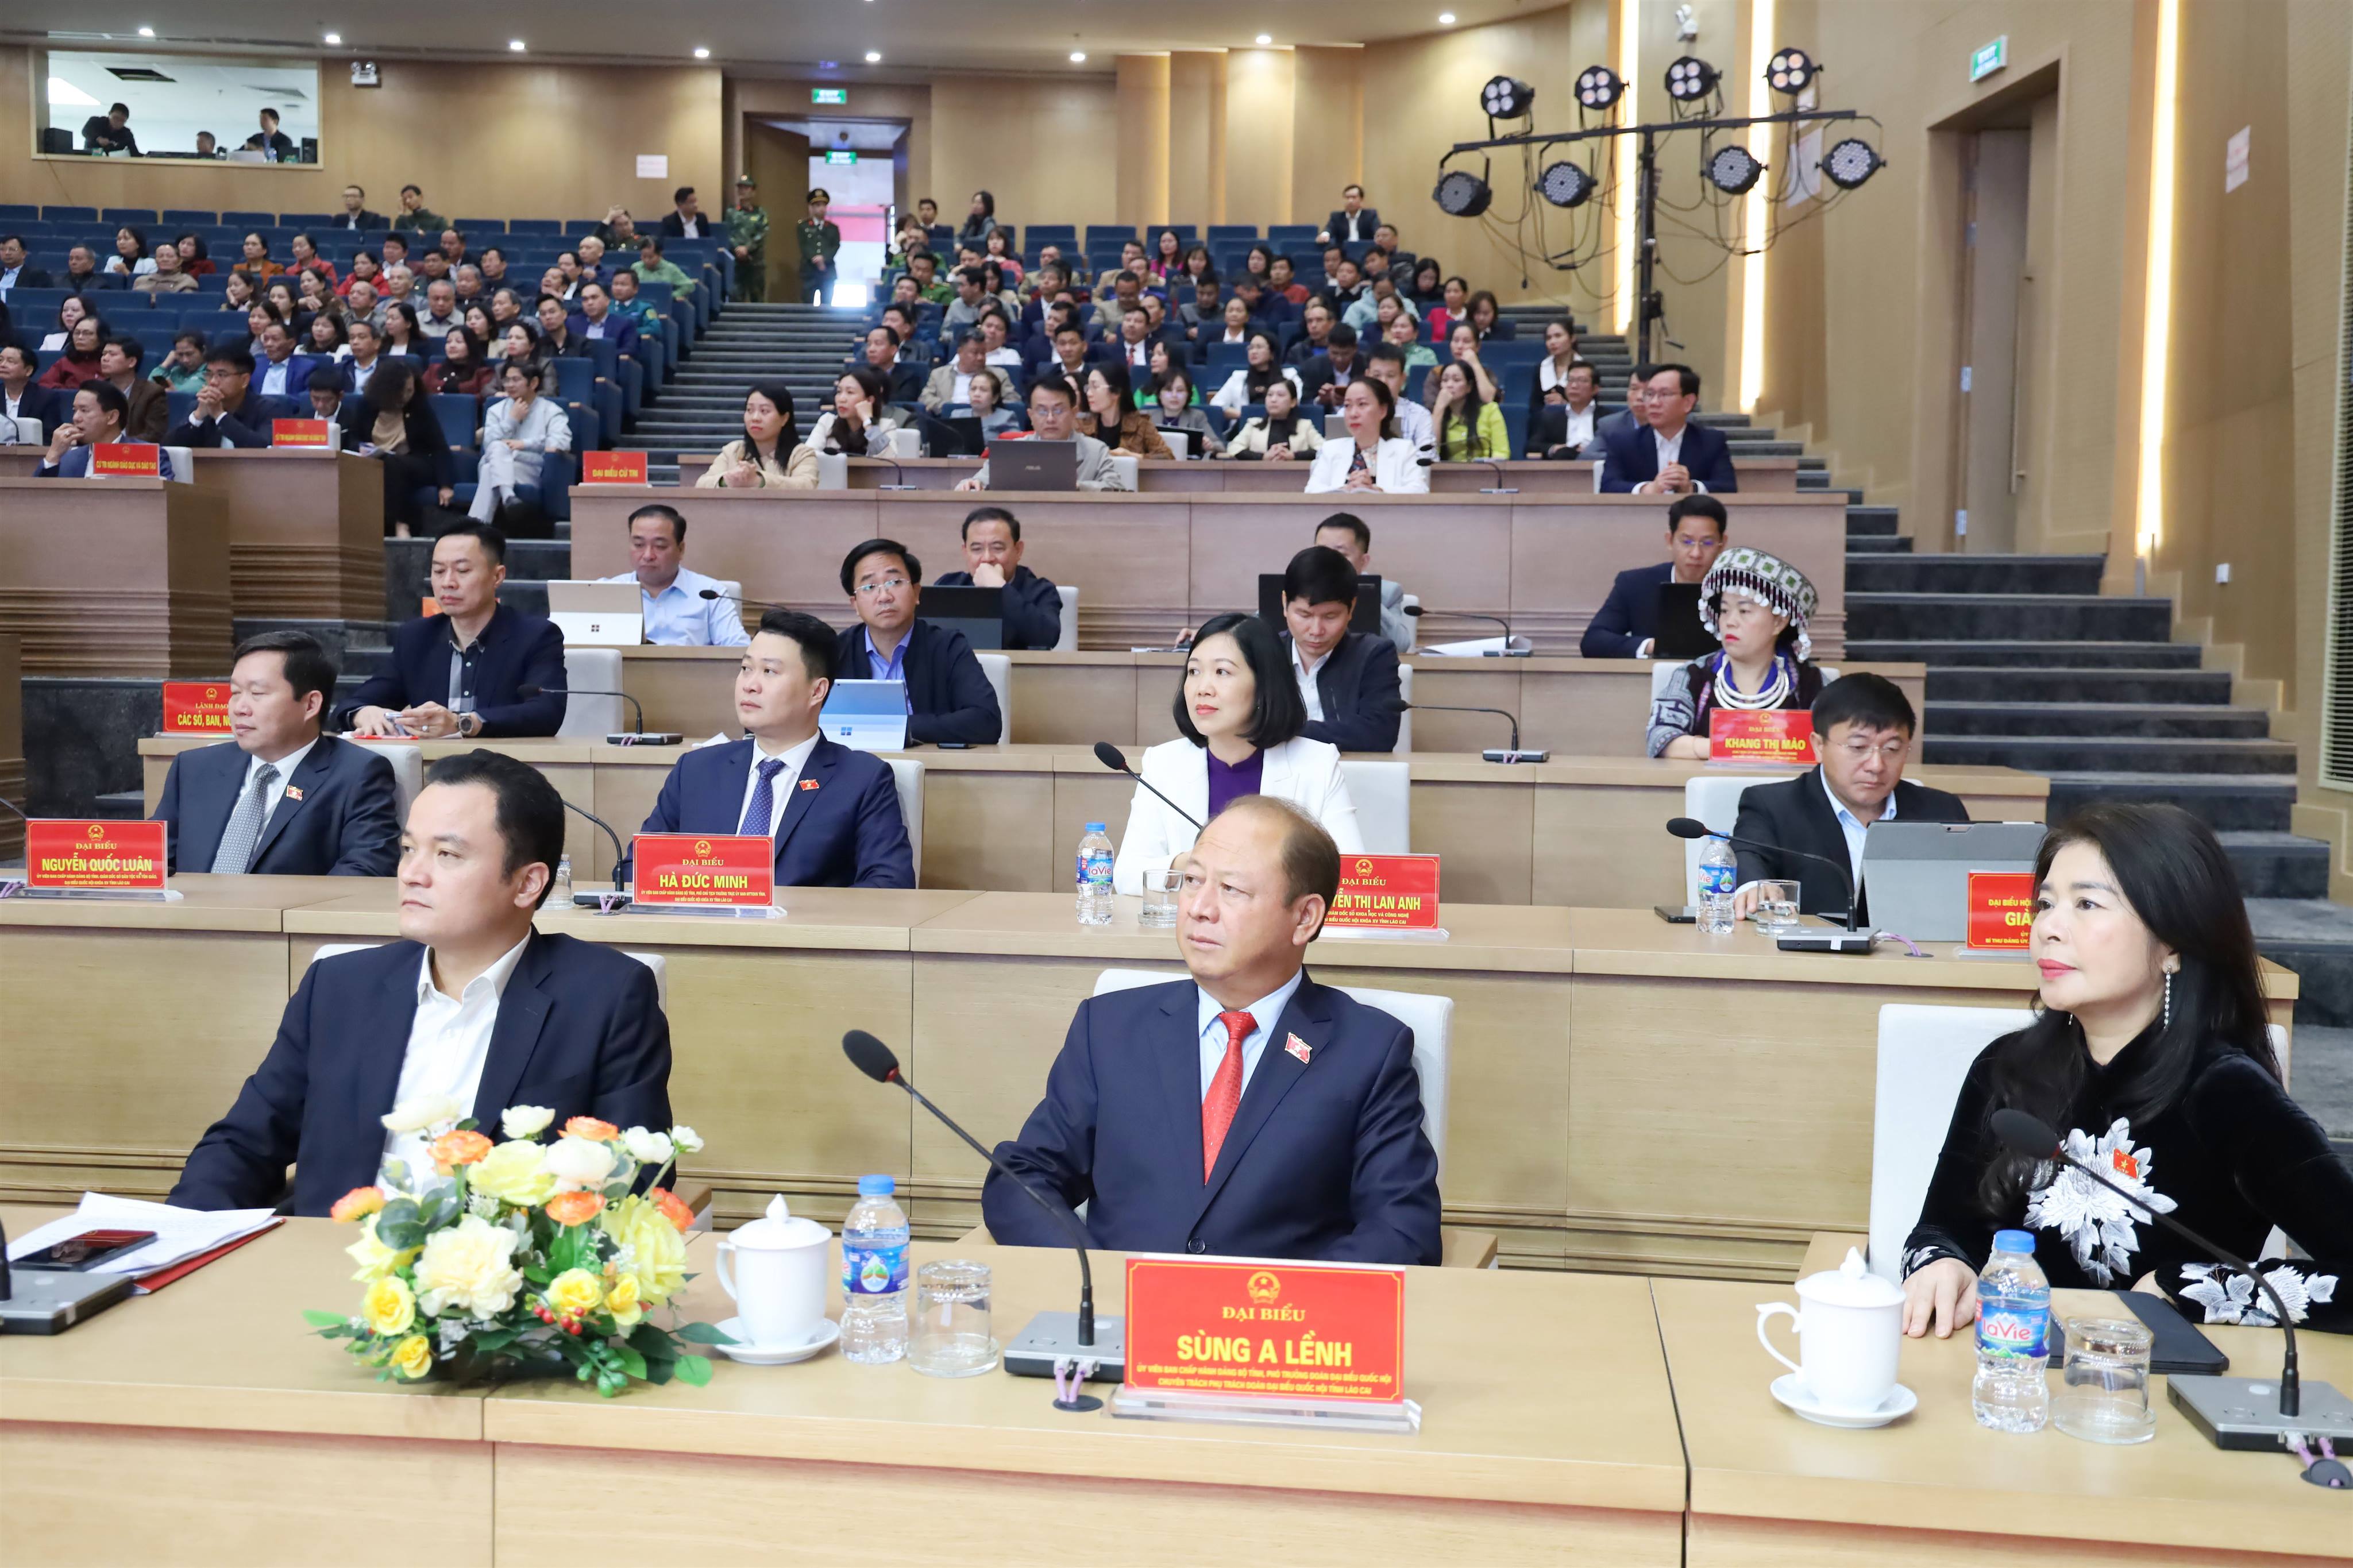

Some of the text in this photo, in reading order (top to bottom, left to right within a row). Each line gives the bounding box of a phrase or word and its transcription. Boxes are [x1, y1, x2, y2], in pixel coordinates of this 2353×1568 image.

[178, 711, 191, 725] CÁC
[193, 710, 204, 727] SỞ,
[206, 715, 221, 728] BAN,
[1725, 737, 1761, 749] KHANG
[1762, 739, 1780, 752] THỊ
[76, 840, 117, 851] ĐẠI BIỂU
[42, 852, 86, 871] NGUYỄN
[90, 853, 119, 871] QUỐC
[702, 856, 724, 866] BIỂU
[660, 871, 747, 889] HÀ ĐỨC MINH
[1341, 875, 1387, 886] ĐẠI BIỂU
[1332, 887, 1421, 912] YỄN THỊ LAN ANH
[1988, 899, 2001, 907] ĐẠI
[2003, 896, 2018, 906] BIỂU
[1222, 1303, 1306, 1322] ĐẠI BIỂU
[1177, 1329, 1352, 1367] SÙNG A LỀNH
